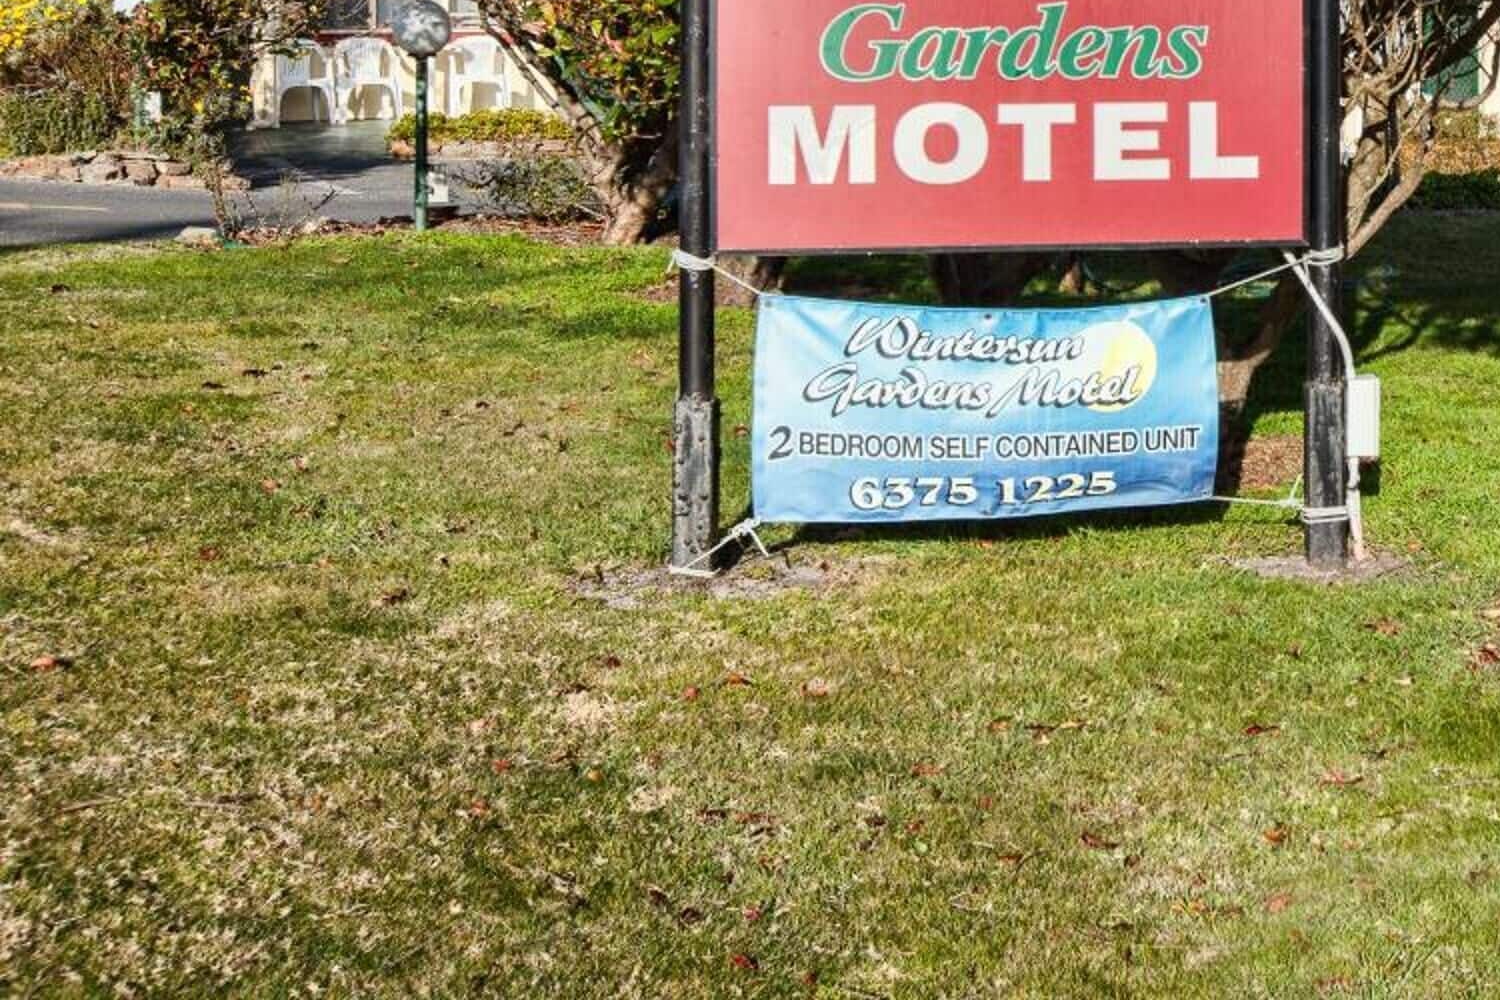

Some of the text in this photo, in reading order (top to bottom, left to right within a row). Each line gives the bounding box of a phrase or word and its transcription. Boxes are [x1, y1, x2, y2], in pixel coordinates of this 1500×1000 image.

[819, 1, 1208, 82] Gardens
[767, 101, 1259, 185] MOTEL
[843, 313, 1087, 365] Wintersun
[802, 361, 1142, 418] Gardens Motel
[768, 425, 1200, 460] 2 BEDROOM SELF CONTAINED UNIT
[850, 470, 1118, 511] 6375 1225
